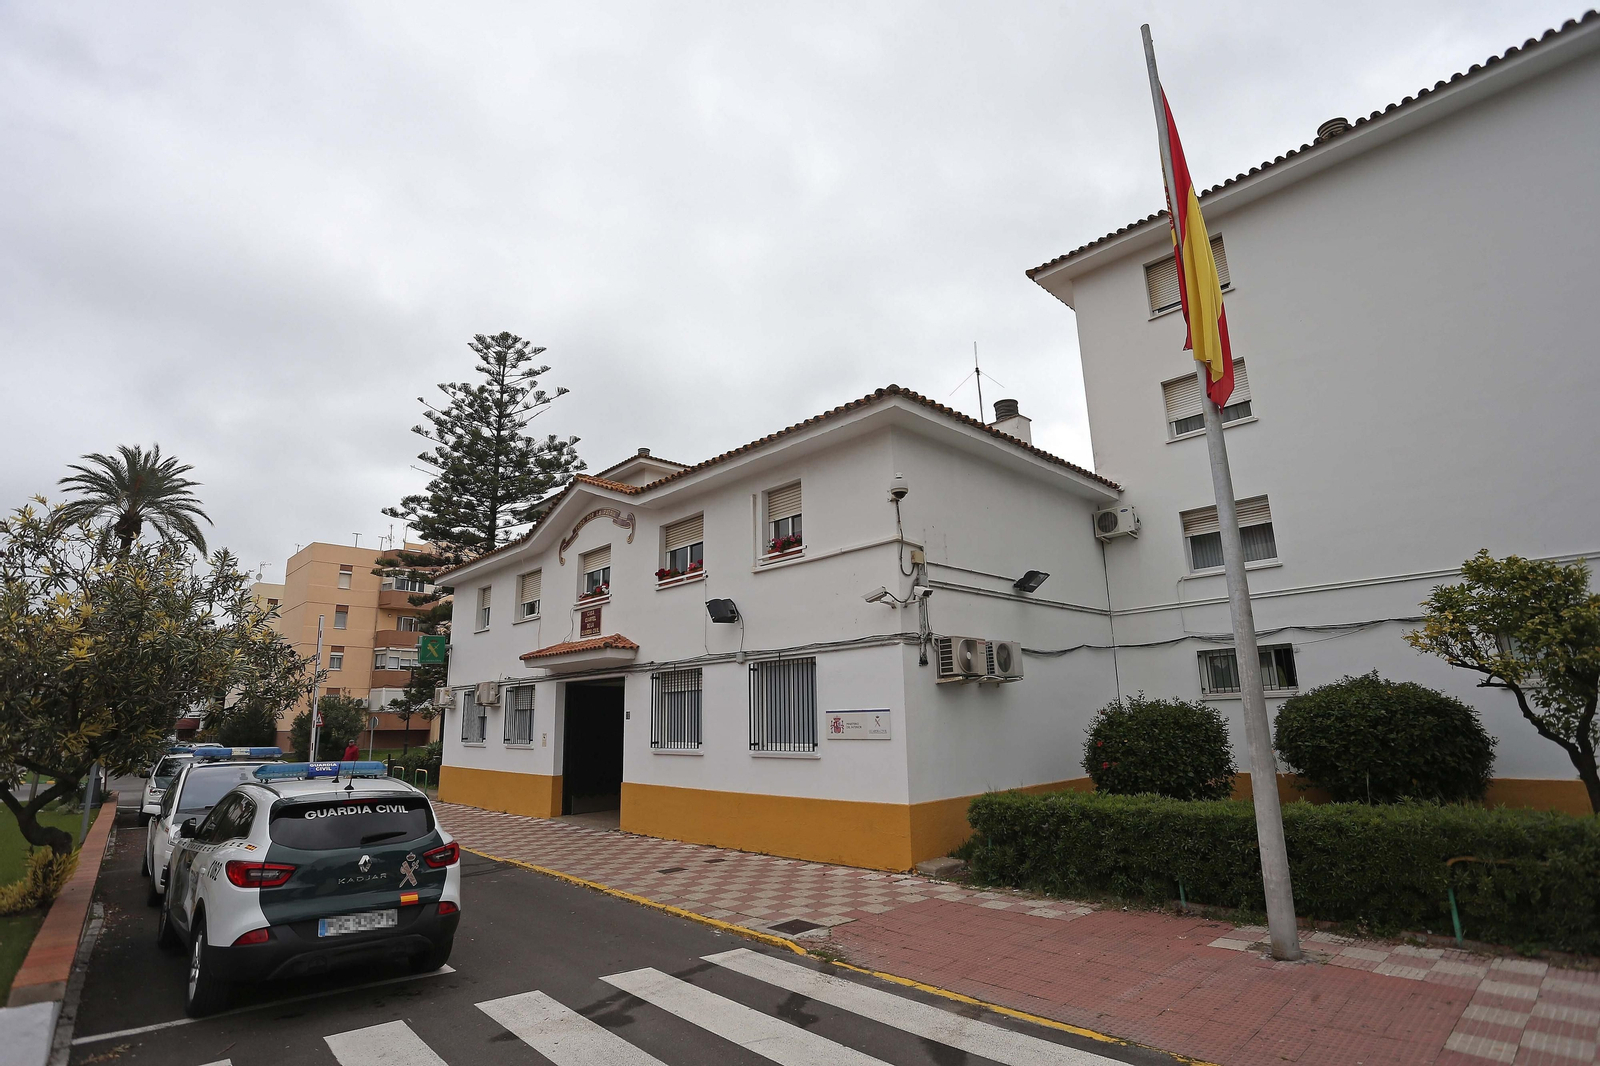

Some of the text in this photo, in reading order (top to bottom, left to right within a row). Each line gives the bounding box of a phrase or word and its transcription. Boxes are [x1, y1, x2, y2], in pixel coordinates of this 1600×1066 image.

[304, 804, 409, 820] GUARDIA CIVIL
[338, 872, 388, 885] KADJAR
